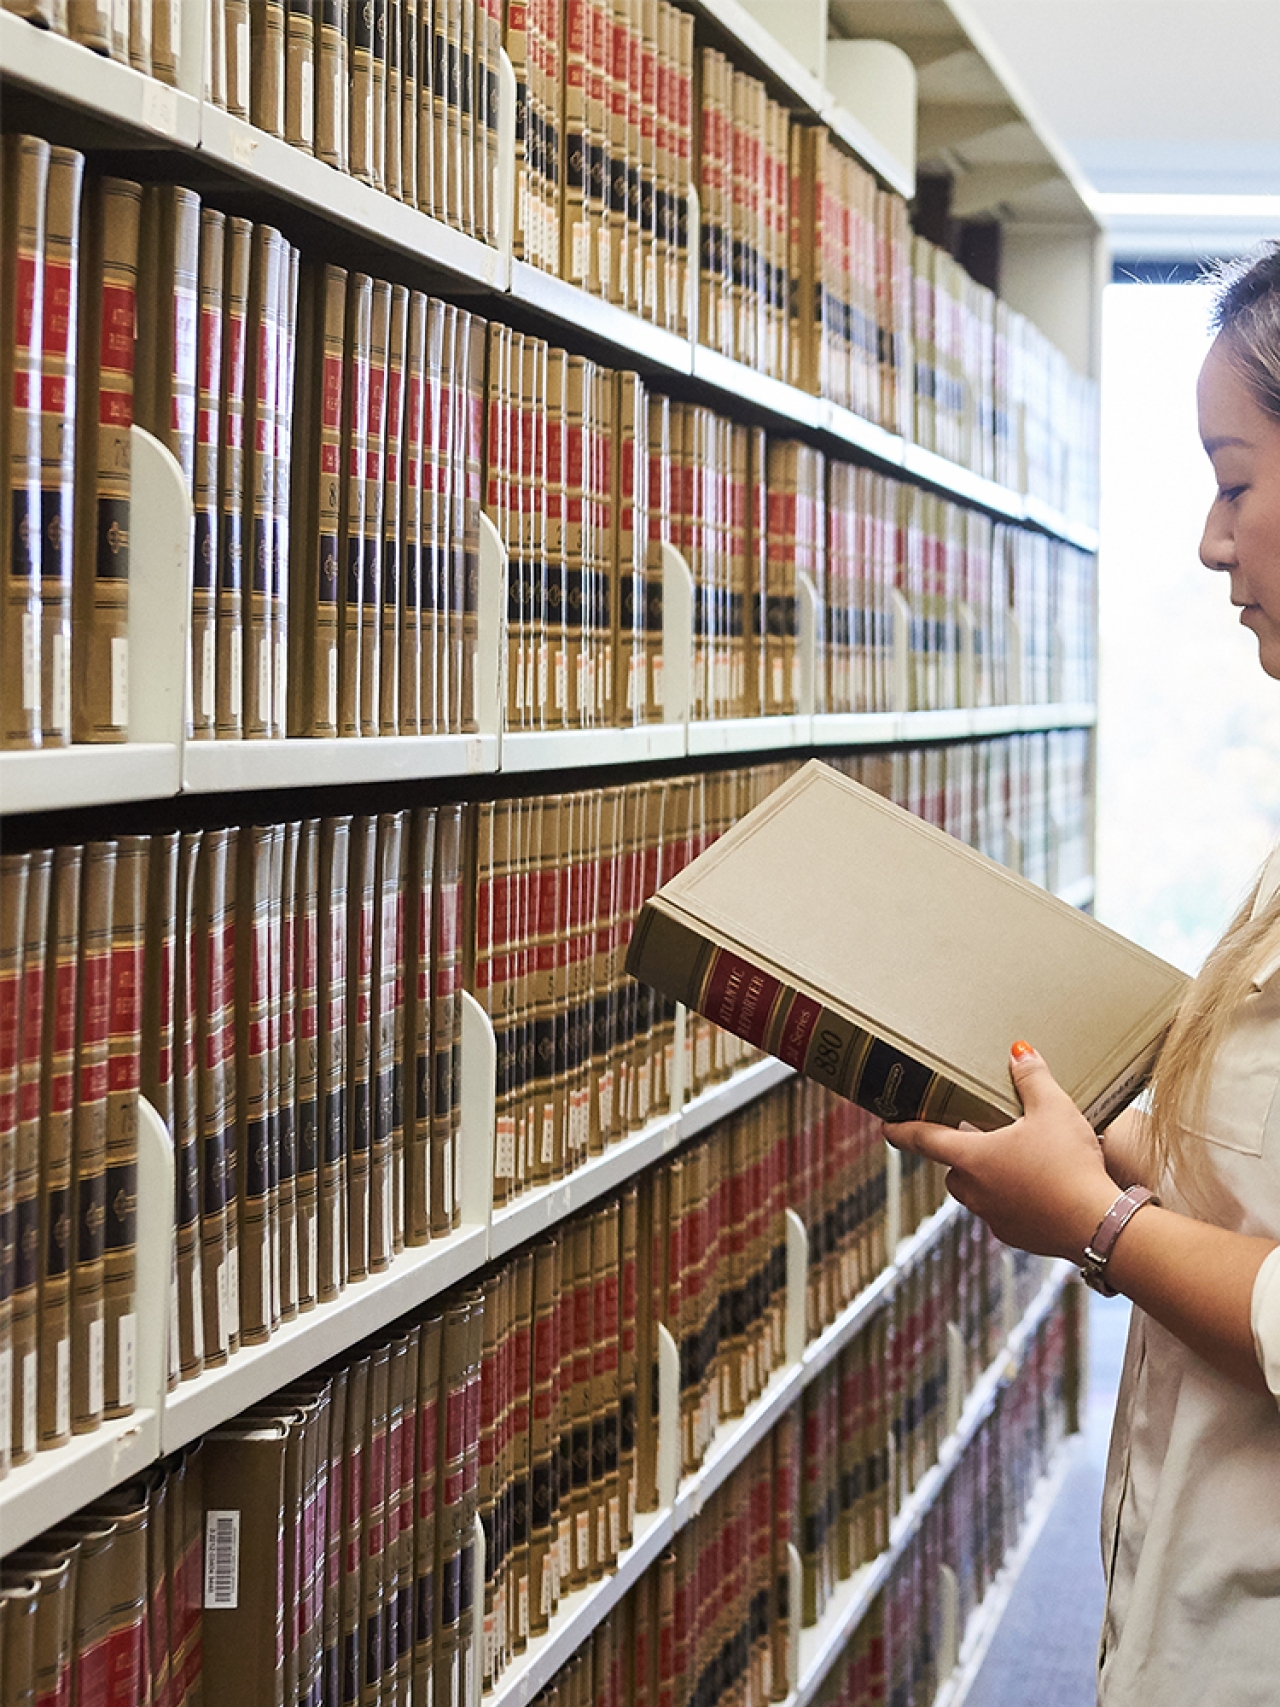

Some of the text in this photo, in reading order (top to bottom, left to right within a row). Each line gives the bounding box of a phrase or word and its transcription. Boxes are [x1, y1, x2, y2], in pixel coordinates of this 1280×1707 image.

[720, 967, 745, 1023] ATLANTIC
[737, 974, 765, 1037] REPORTER
[791, 1010, 812, 1046] Series
[814, 1030, 843, 1076] 880
